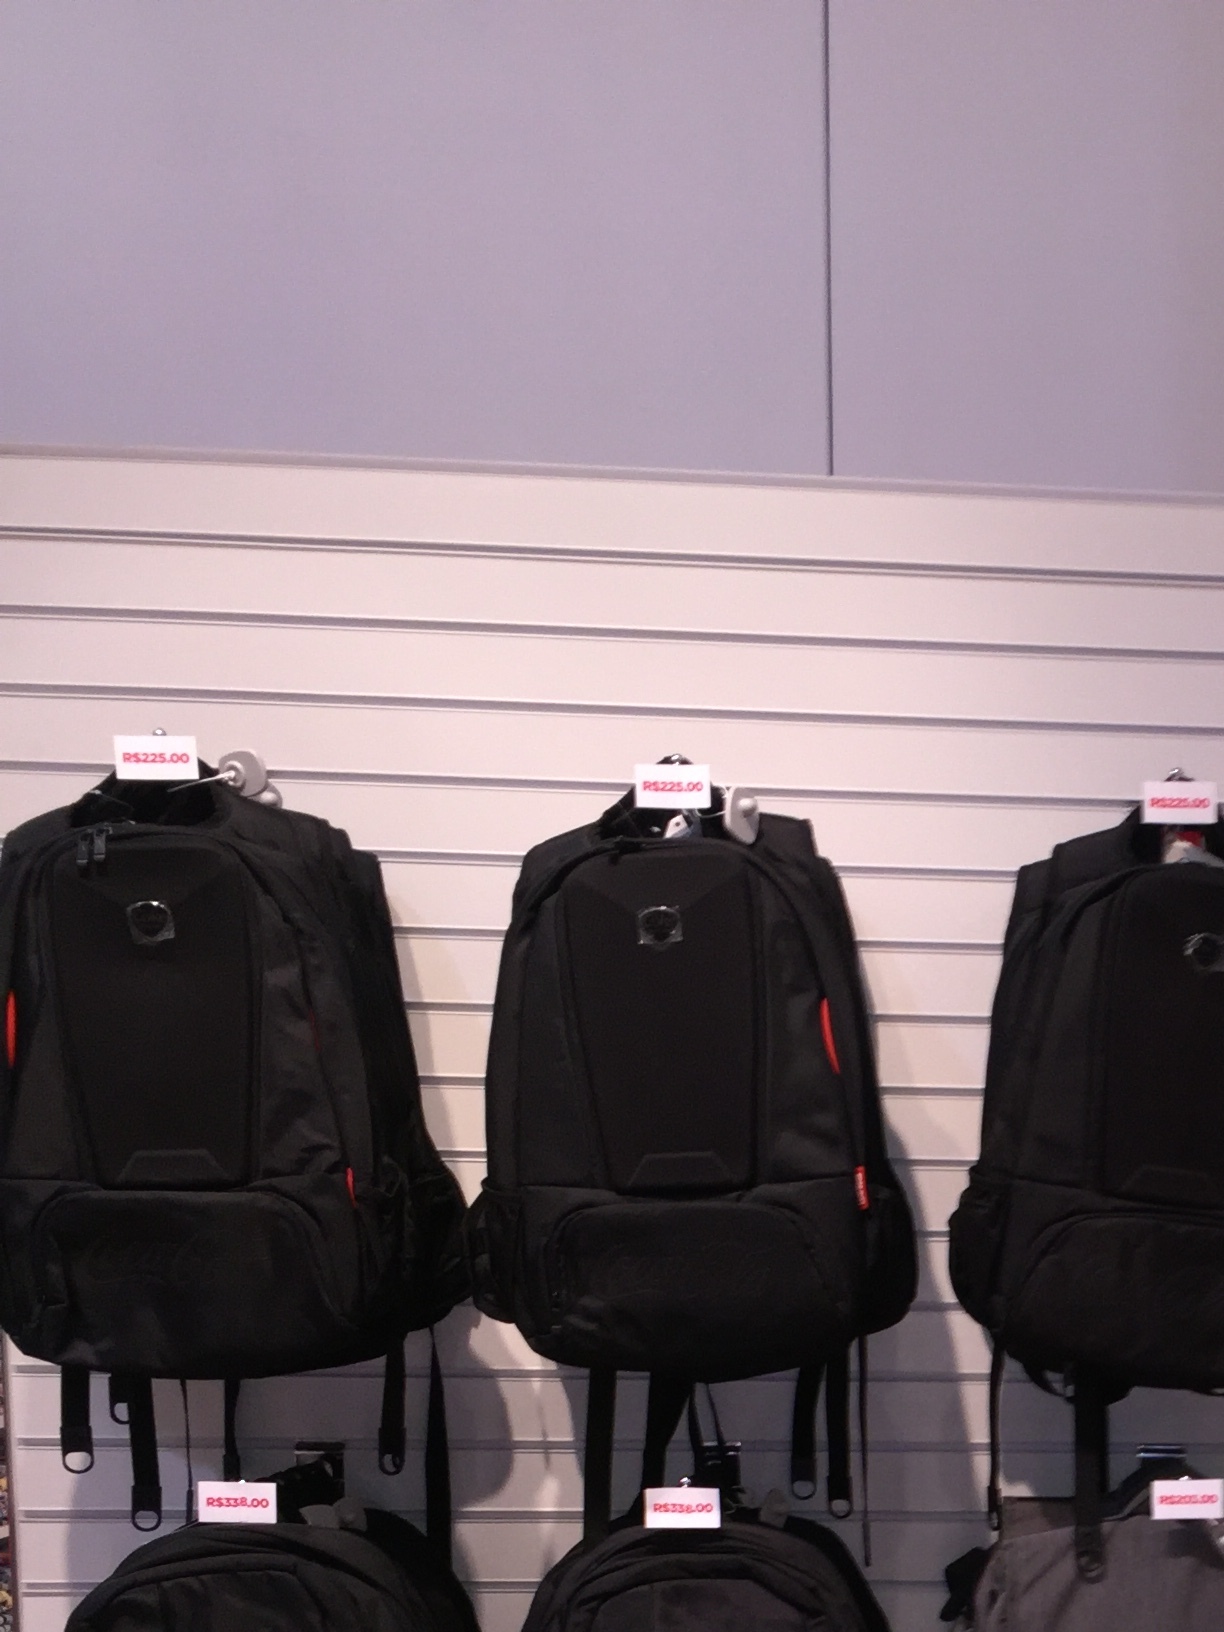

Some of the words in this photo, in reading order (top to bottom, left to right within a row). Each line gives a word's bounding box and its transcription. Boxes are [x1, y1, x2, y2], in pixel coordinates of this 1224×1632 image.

[122, 752, 190, 765] R$225.00
[643, 781, 704, 793] R$225.00
[206, 1497, 269, 1509] R$338.00
